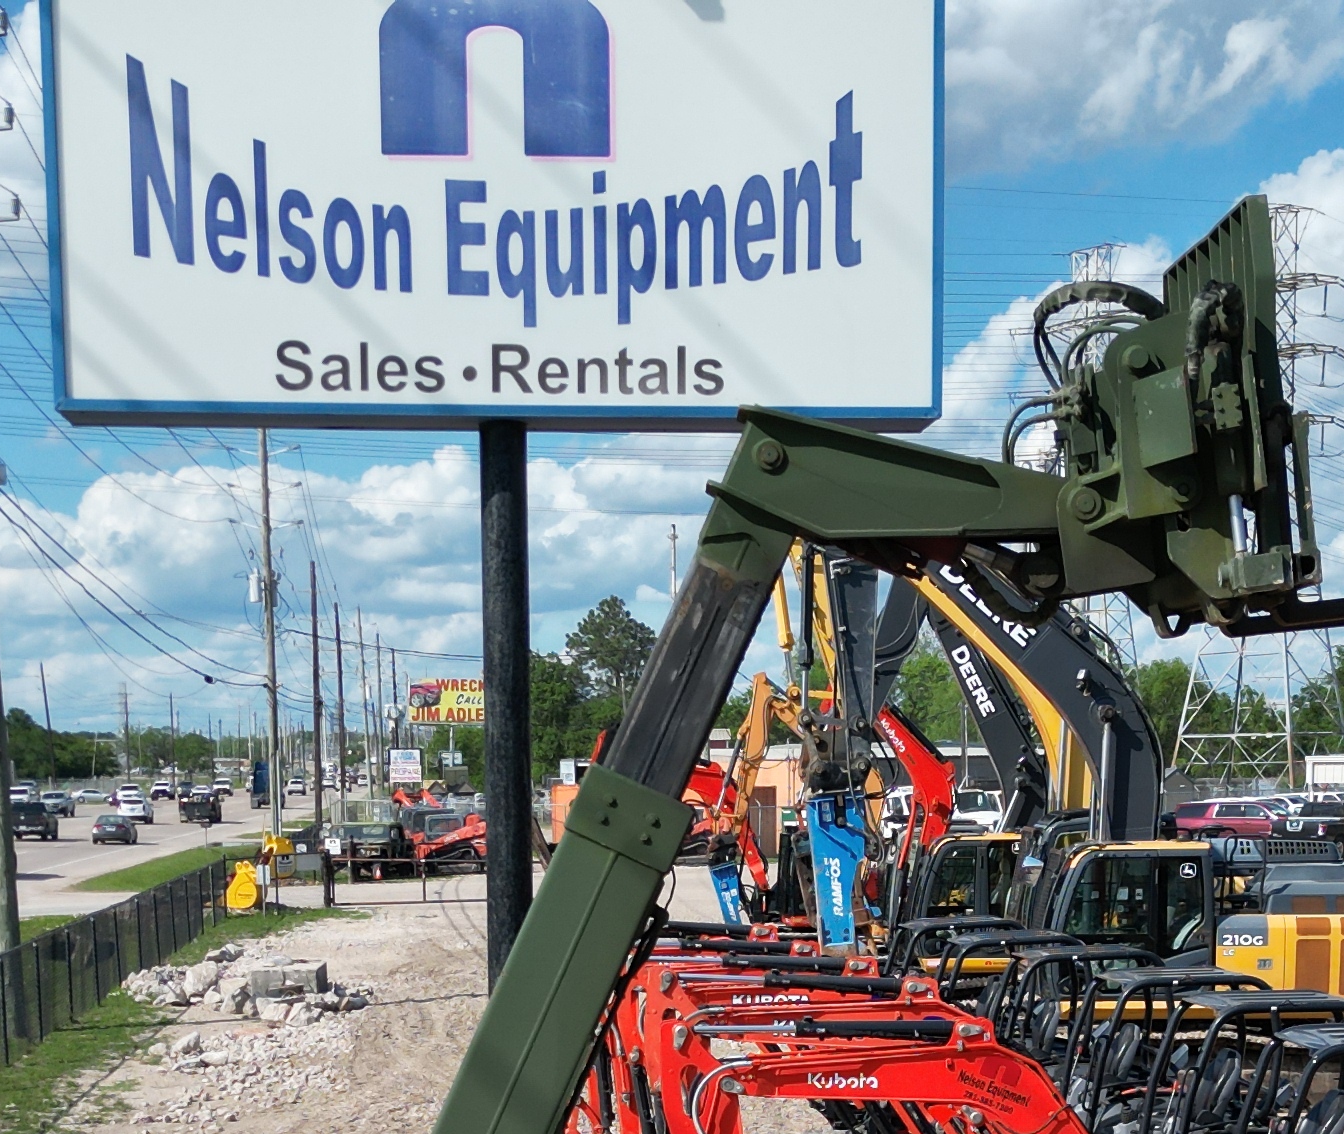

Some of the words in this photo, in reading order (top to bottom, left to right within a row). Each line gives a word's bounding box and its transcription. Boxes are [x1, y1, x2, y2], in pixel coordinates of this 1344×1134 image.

[126, 53, 413, 295] Nelson
[445, 90, 863, 328] Equipment
[274, 340, 446, 394] Sales
[491, 343, 725, 396] Rentals
[939, 565, 1038, 647] DEE
[951, 644, 996, 718] DEERE
[412, 707, 440, 722] JIM
[445, 708, 484, 722] ADLE
[456, 694, 482, 705] CALL
[1222, 934, 1264, 946] 210G
[807, 1072, 879, 1089] Kubota
